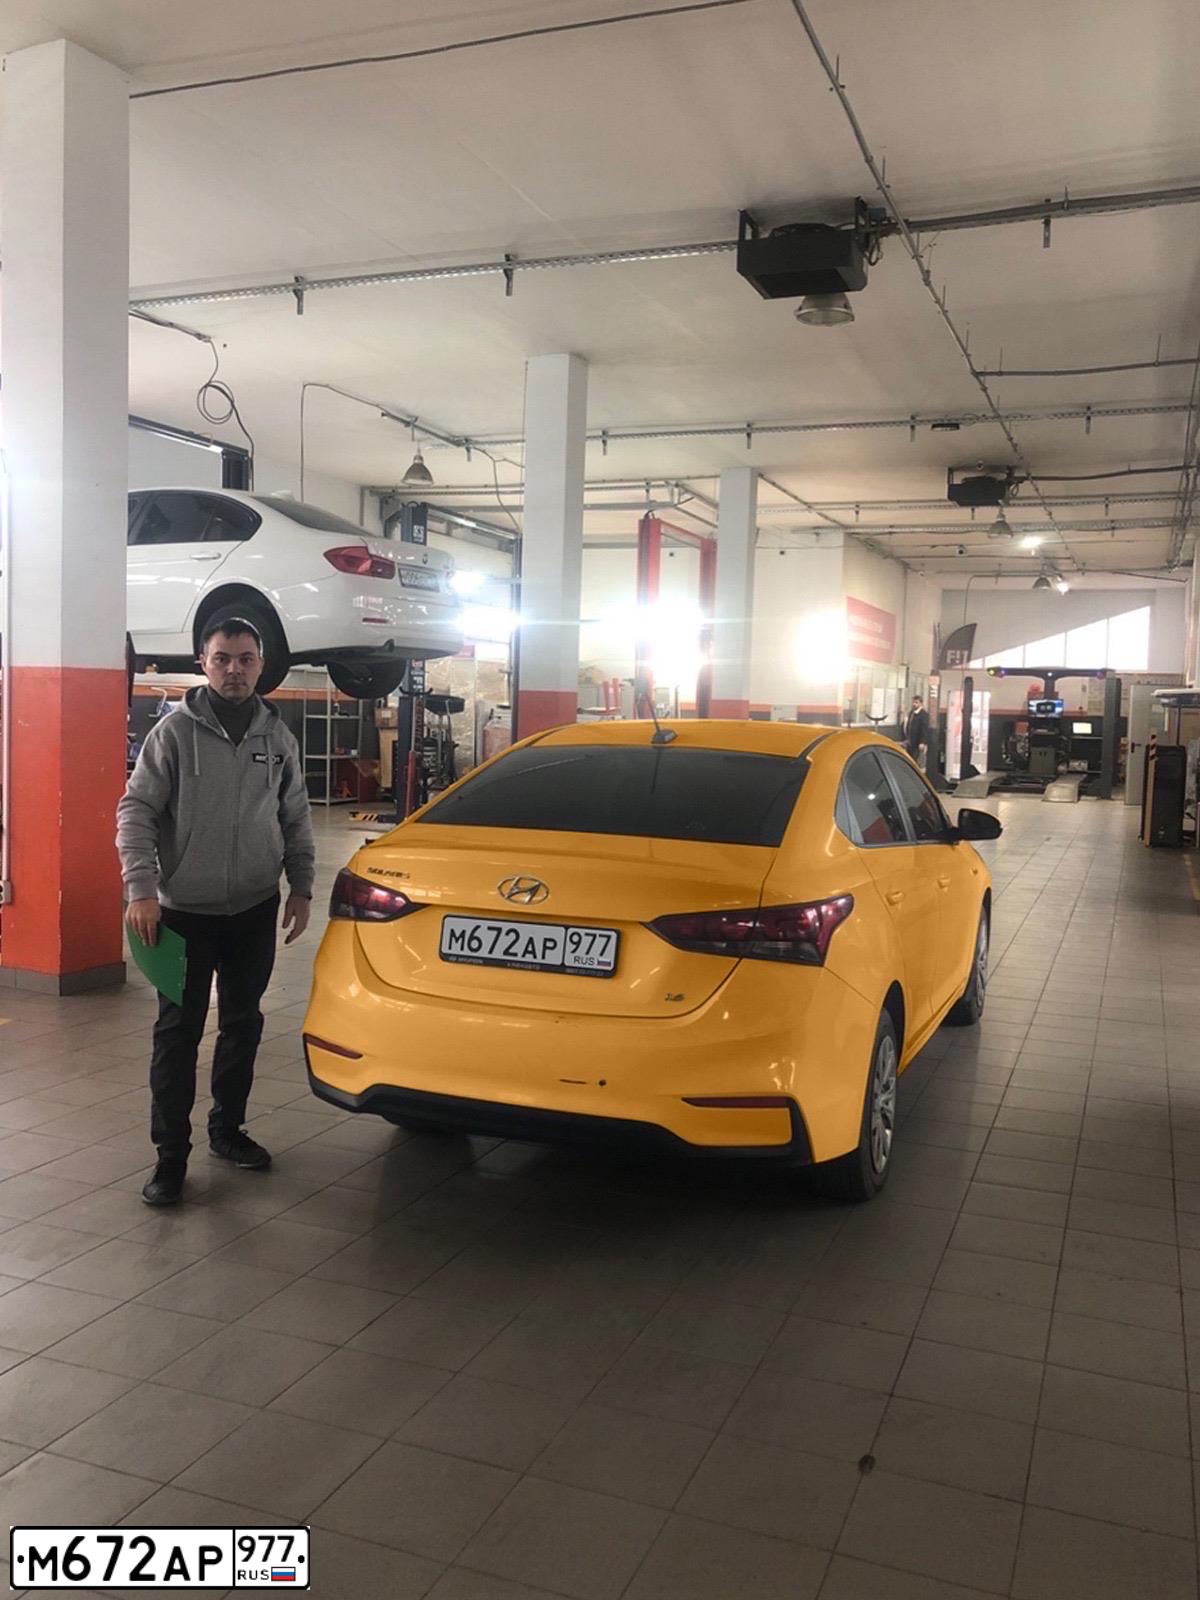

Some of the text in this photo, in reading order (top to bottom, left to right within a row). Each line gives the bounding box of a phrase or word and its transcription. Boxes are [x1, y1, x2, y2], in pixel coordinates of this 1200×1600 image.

[448, 925, 612, 960] M672AP 977
[573, 955, 595, 966] RUS
